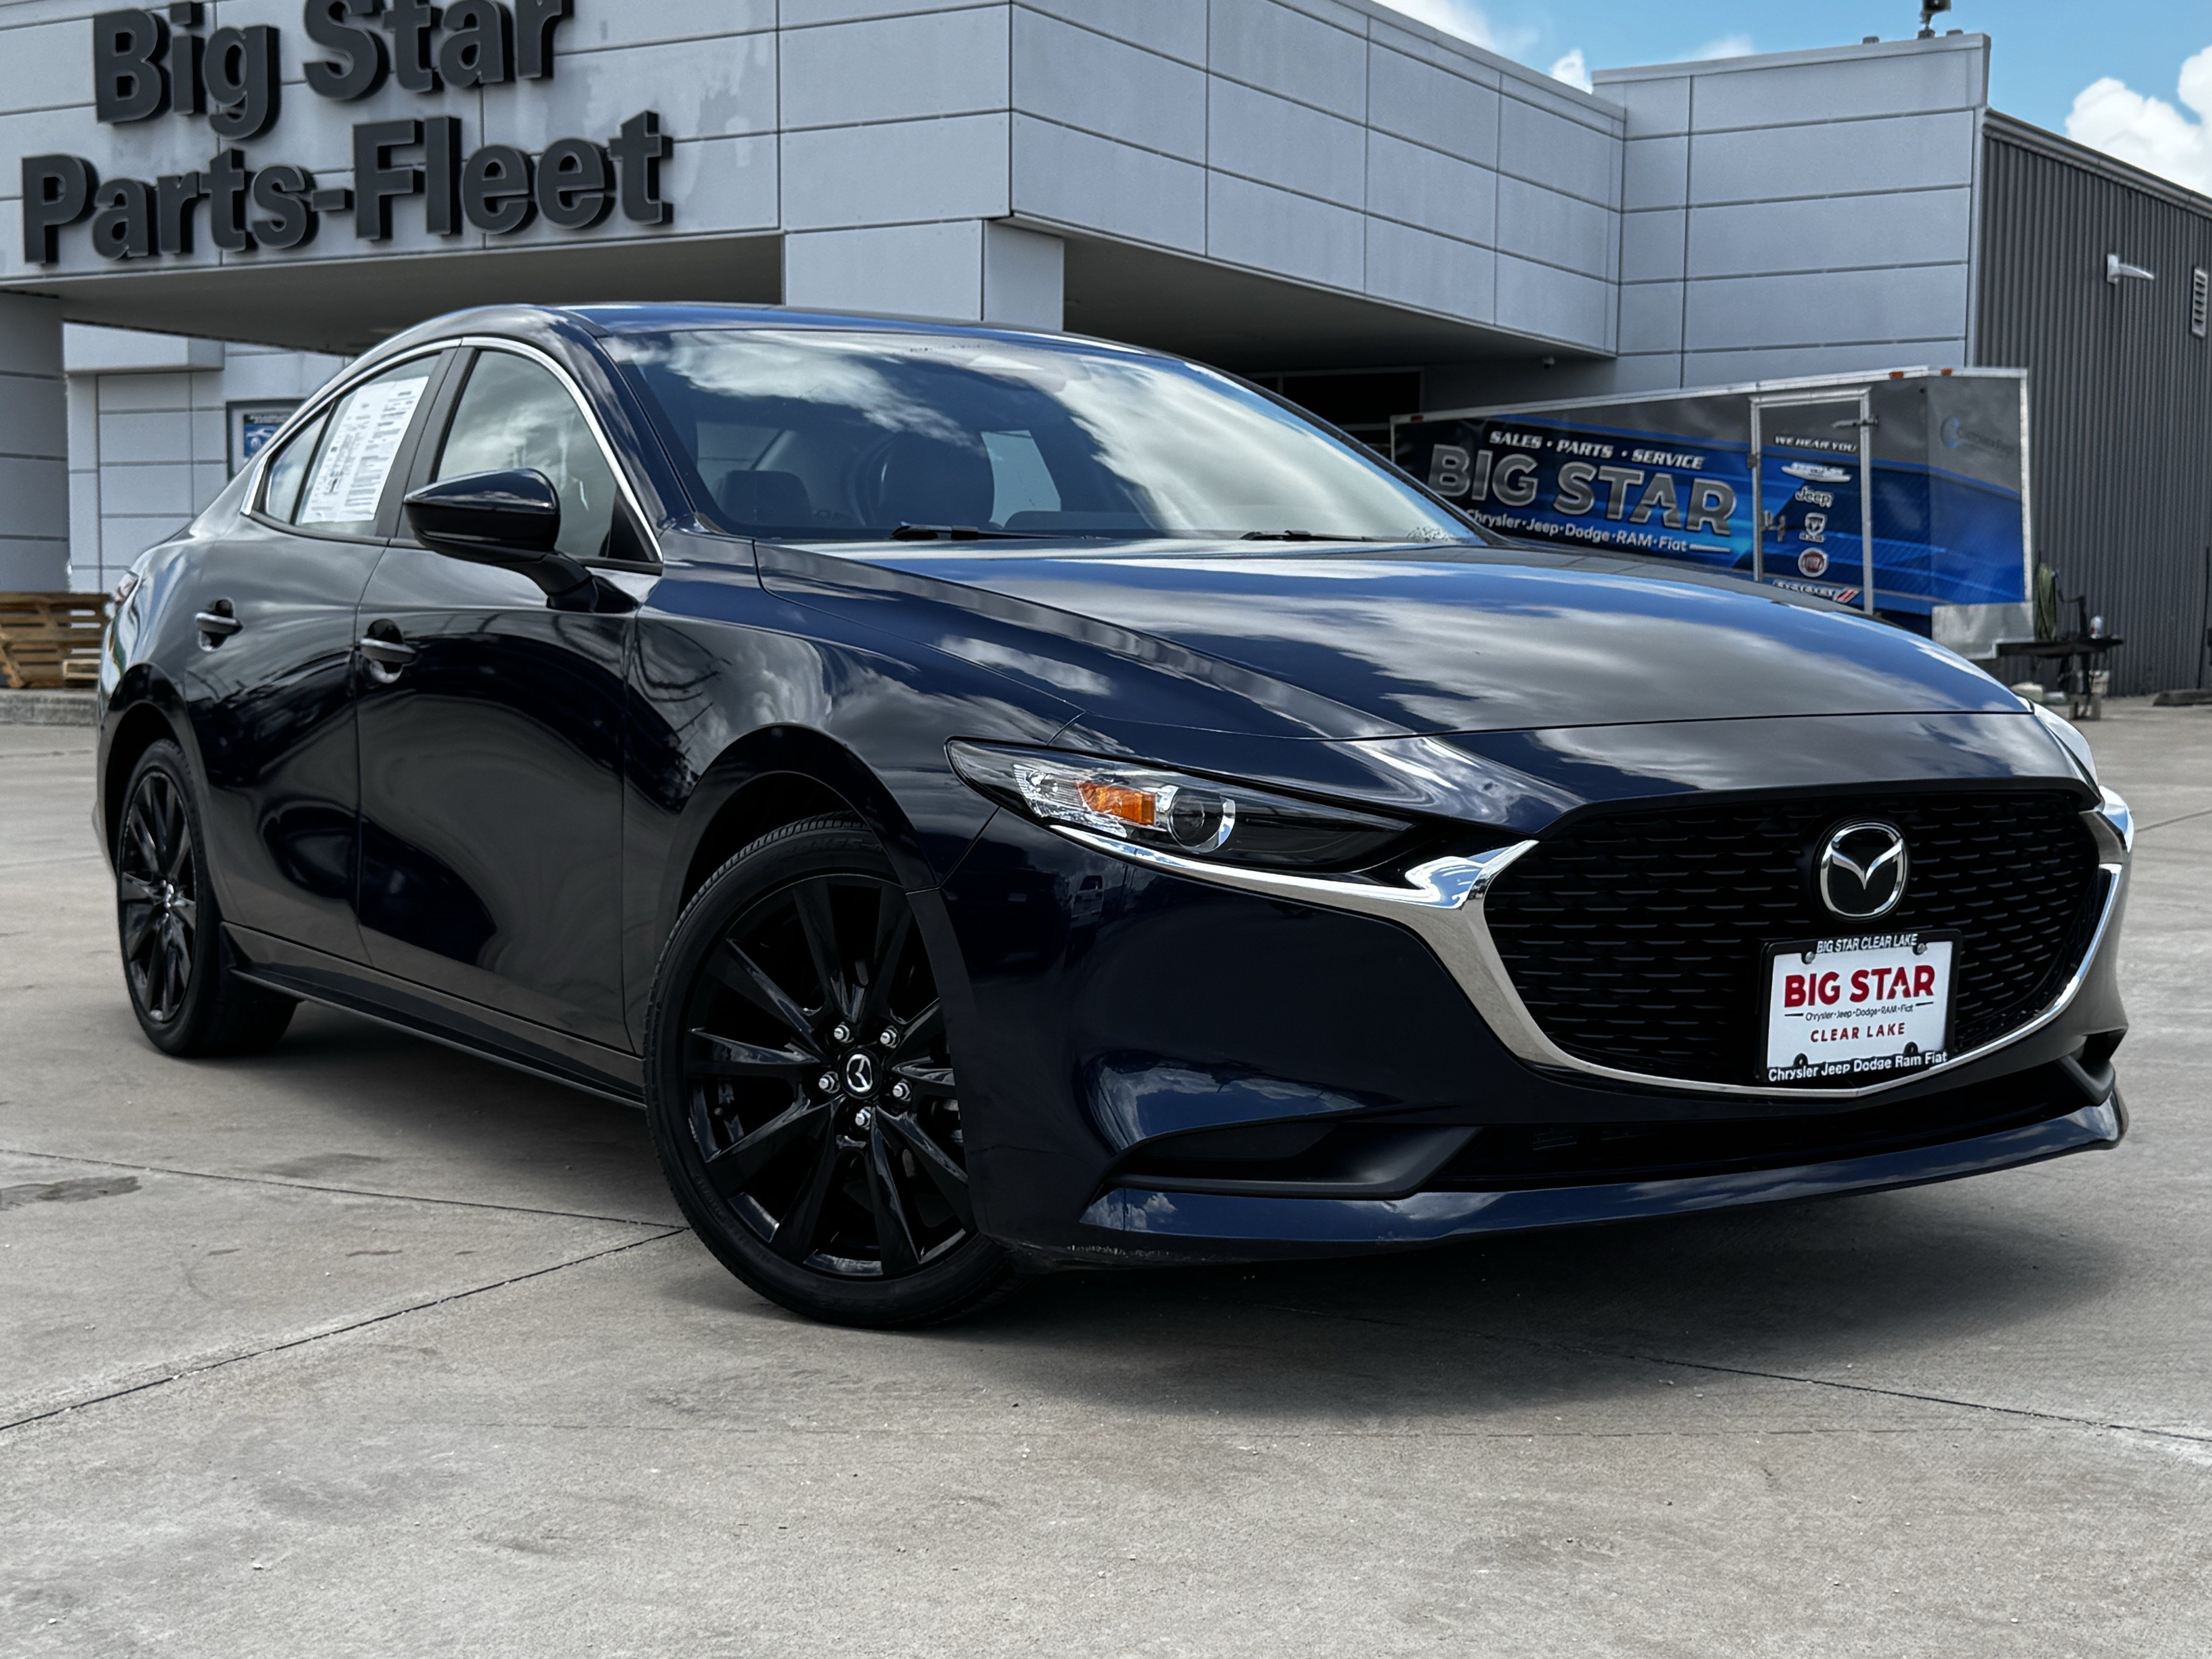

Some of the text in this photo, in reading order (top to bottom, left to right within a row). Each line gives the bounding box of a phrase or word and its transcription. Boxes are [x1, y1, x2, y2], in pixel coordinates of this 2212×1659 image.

[93, 0, 574, 139] Big Star
[21, 110, 673, 264] Parts-Fleet
[1489, 430, 1706, 469] SALES PARTS SERVICE
[1428, 444, 1736, 536] BIG STAR
[1795, 485, 1834, 508] Jeep
[1817, 933, 1918, 953] BIG STAR CLEAR LAKE
[1784, 965, 1935, 1008] BIG STAR
[1810, 1022, 1905, 1042] CLEAR LAKE
[1768, 1051, 1948, 1082] Chrysler Jeep Dodge Ram Fiat
